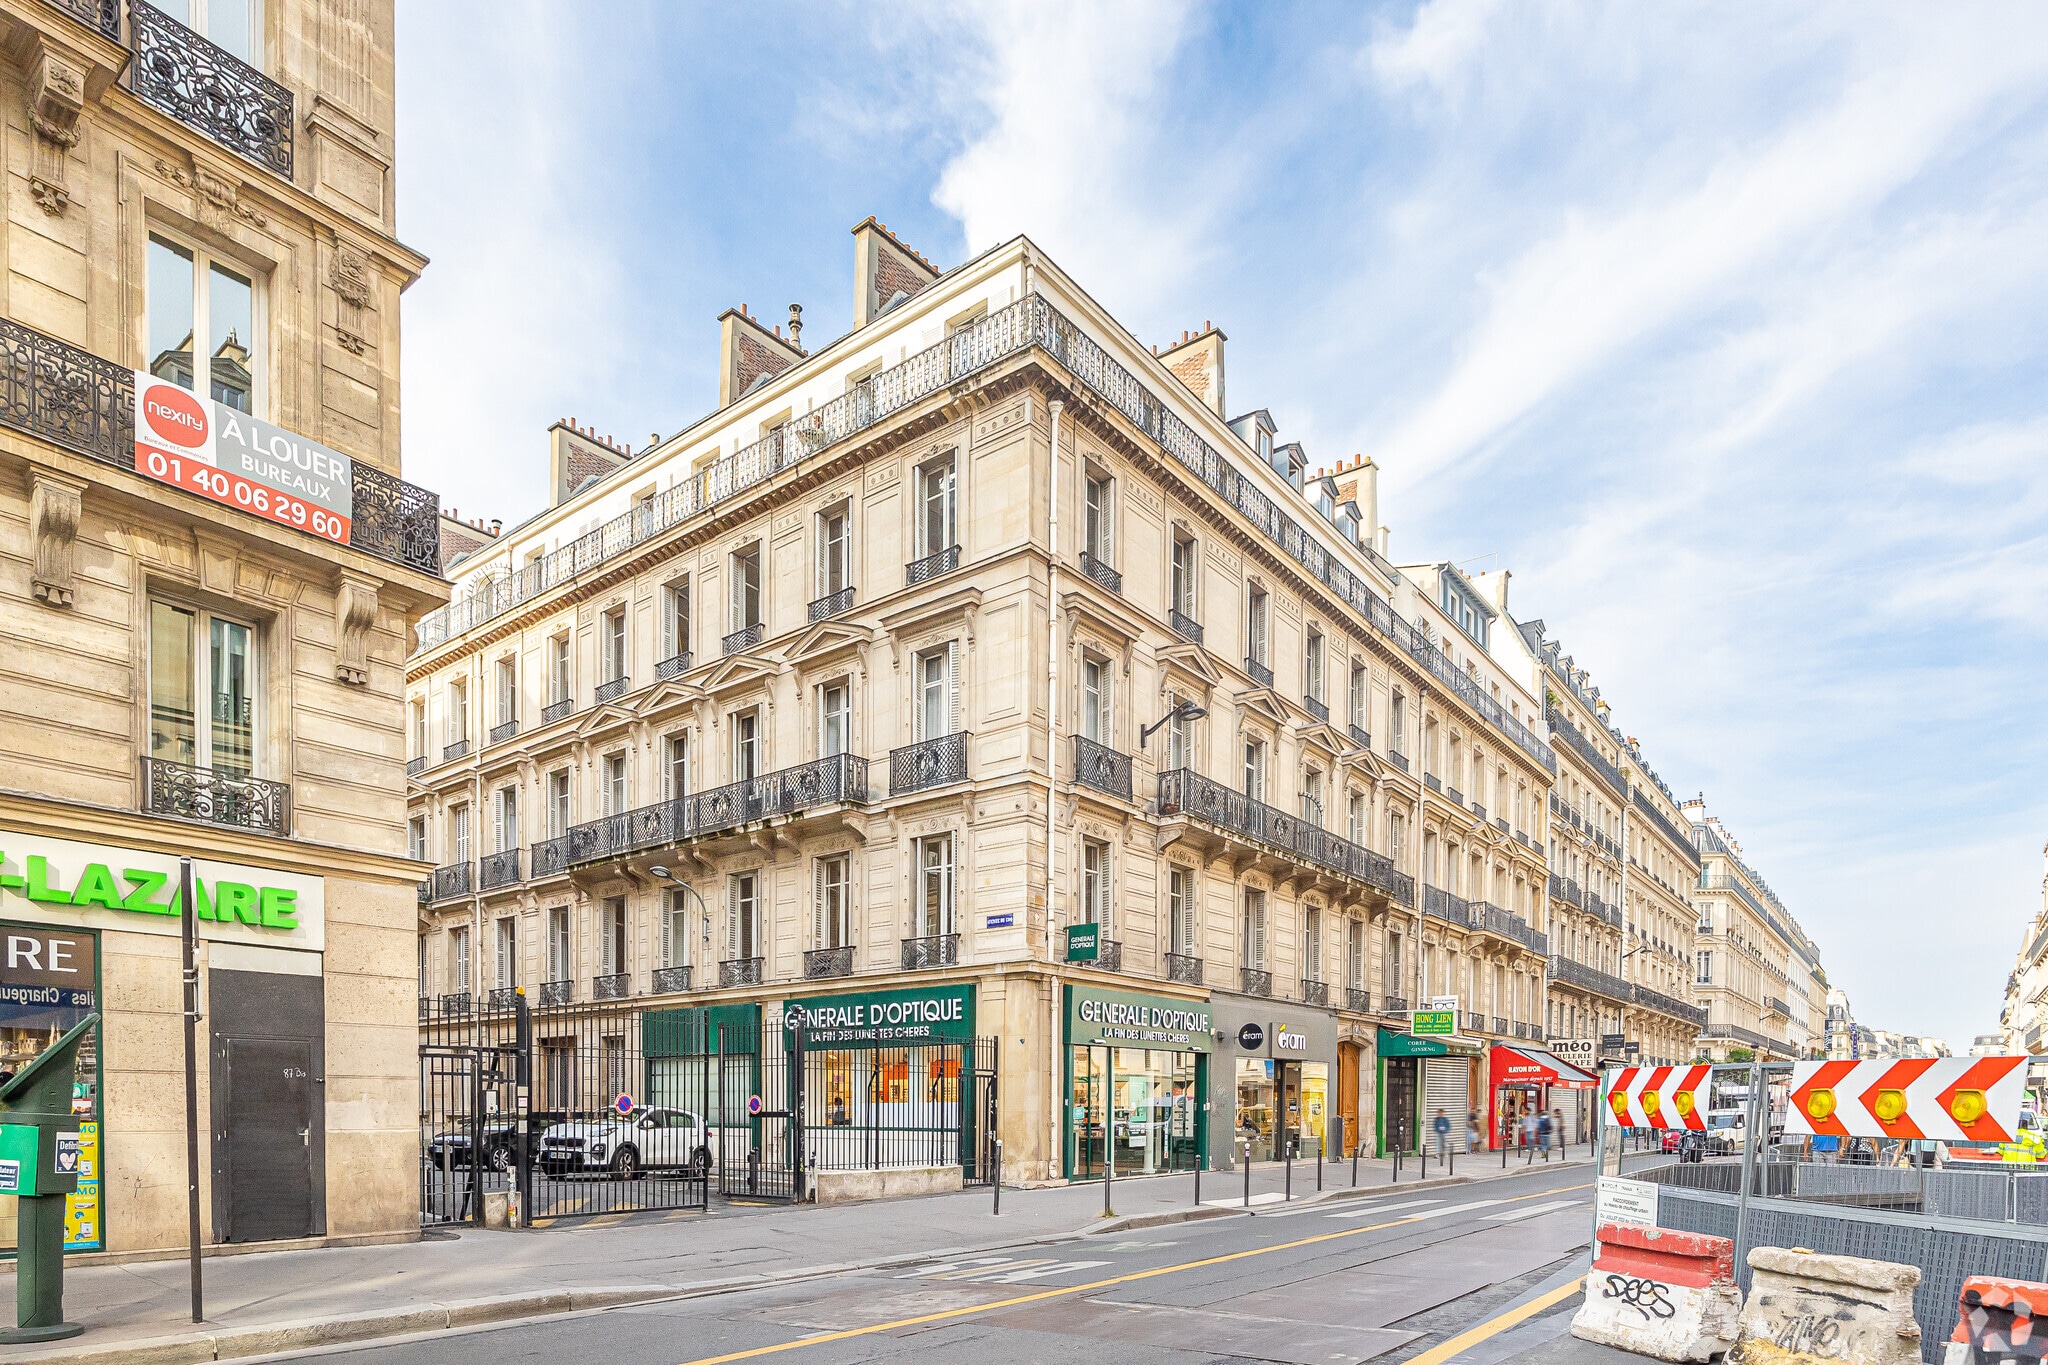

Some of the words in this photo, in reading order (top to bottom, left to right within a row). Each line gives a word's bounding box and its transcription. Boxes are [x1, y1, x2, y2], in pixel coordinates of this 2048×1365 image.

[147, 401, 203, 431] nexity
[222, 410, 246, 446] À
[252, 427, 346, 485] LOUER
[241, 453, 331, 501] BUREAUX
[147, 452, 181, 482] 01
[192, 469, 230, 497] 40
[234, 481, 269, 511] 06
[275, 496, 306, 525] 29
[312, 511, 342, 539] 60
[0, 851, 299, 929] -LAZARE
[1071, 935, 1095, 943] GENERALE
[1071, 941, 1095, 949] D'OPTIQUE
[870, 998, 963, 1025] D'OPTIQUE
[1081, 1000, 1148, 1026] GENERALE
[1152, 1007, 1209, 1033] D'OPTIQUE
[1415, 1014, 1434, 1023] HONG
[1436, 1013, 1452, 1023] LIEN
[811, 1032, 821, 1042] LA
[1104, 1027, 1113, 1037] LA
[1114, 1028, 1125, 1039] FIN
[1127, 1030, 1139, 1040] DES
[1140, 1031, 1167, 1042] LUNETTES
[1168, 1034, 1190, 1043] CHERES
[1243, 1030, 1262, 1040] éram
[1277, 1023, 1306, 1050] éram
[283, 1068, 293, 1079] 87
[1527, 1065, 1541, 1073] D'OR
